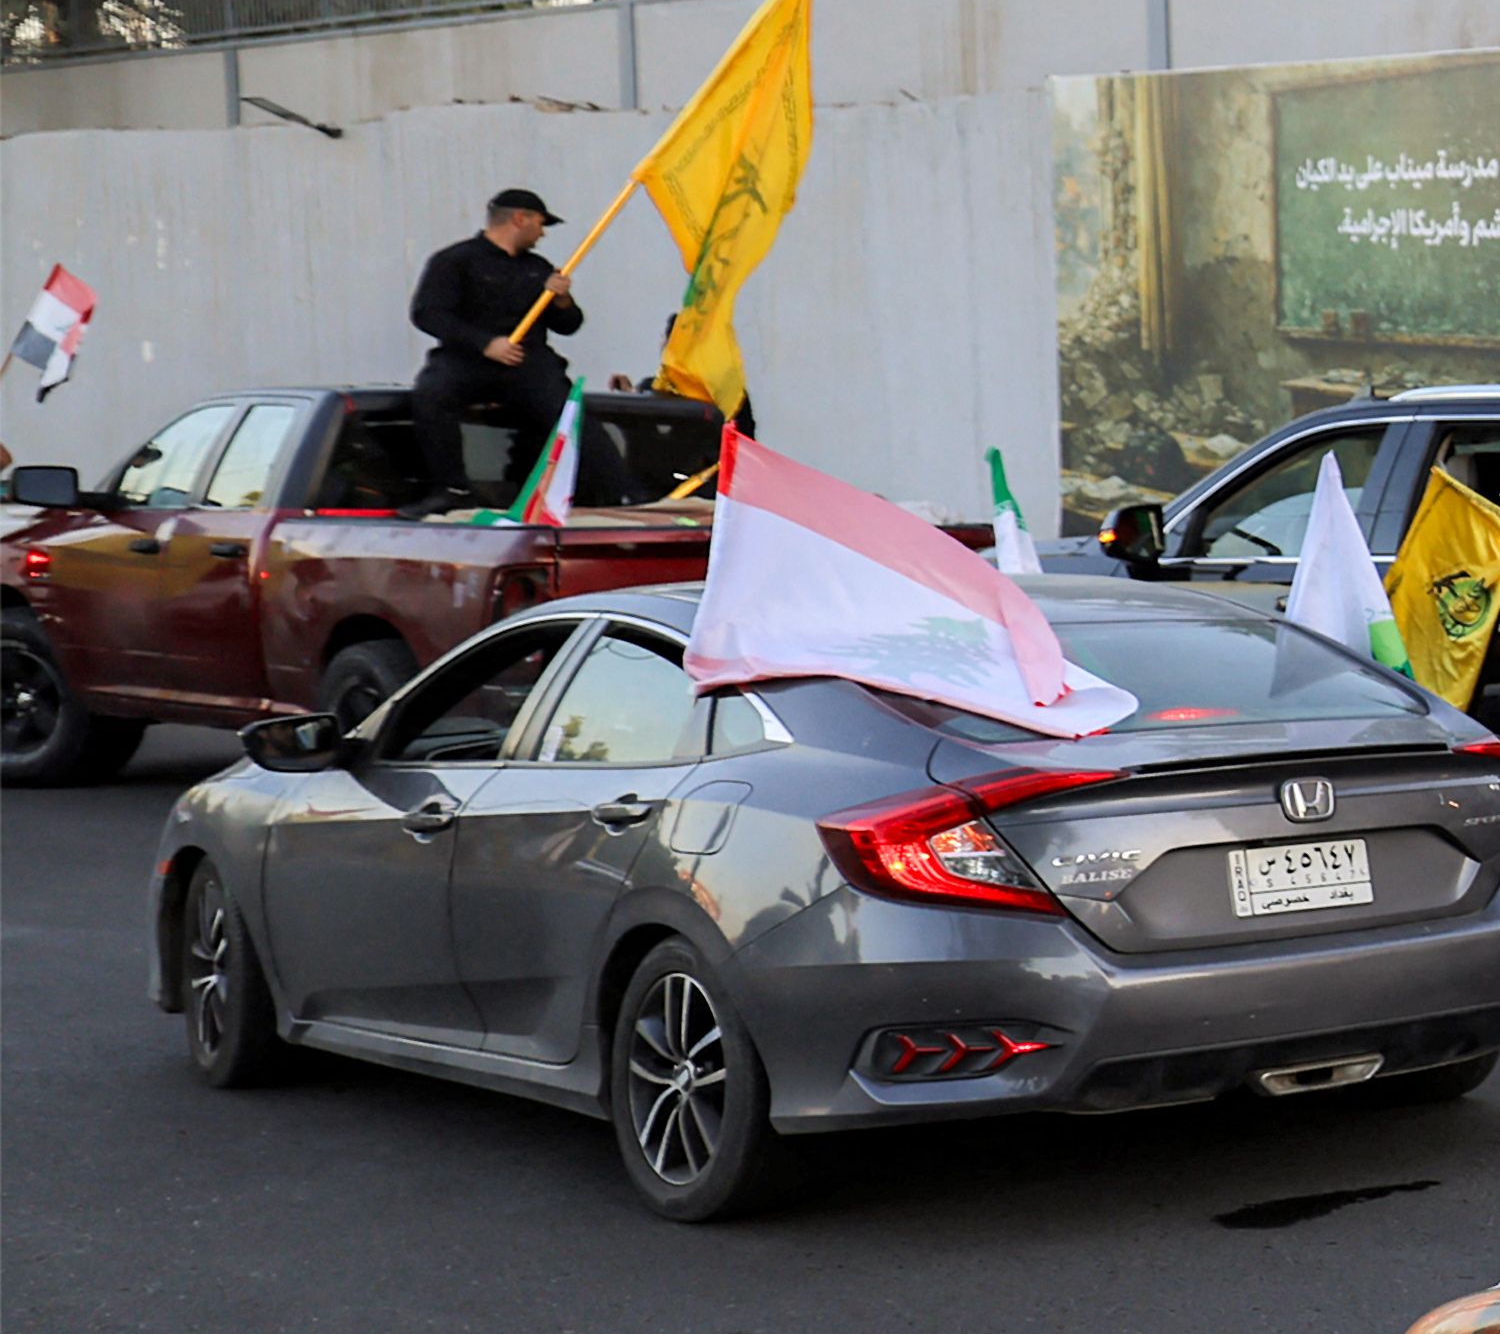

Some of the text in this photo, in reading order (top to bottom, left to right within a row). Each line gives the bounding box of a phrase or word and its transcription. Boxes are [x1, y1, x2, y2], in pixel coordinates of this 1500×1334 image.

[1295, 156, 1335, 191] الكيان
[1355, 154, 1383, 190] على
[1384, 152, 1434, 190] ميناب
[1436, 149, 1499, 188] مدرسة
[1409, 200, 1471, 247] وأمريكا
[1233, 851, 1247, 903] IRAQ
